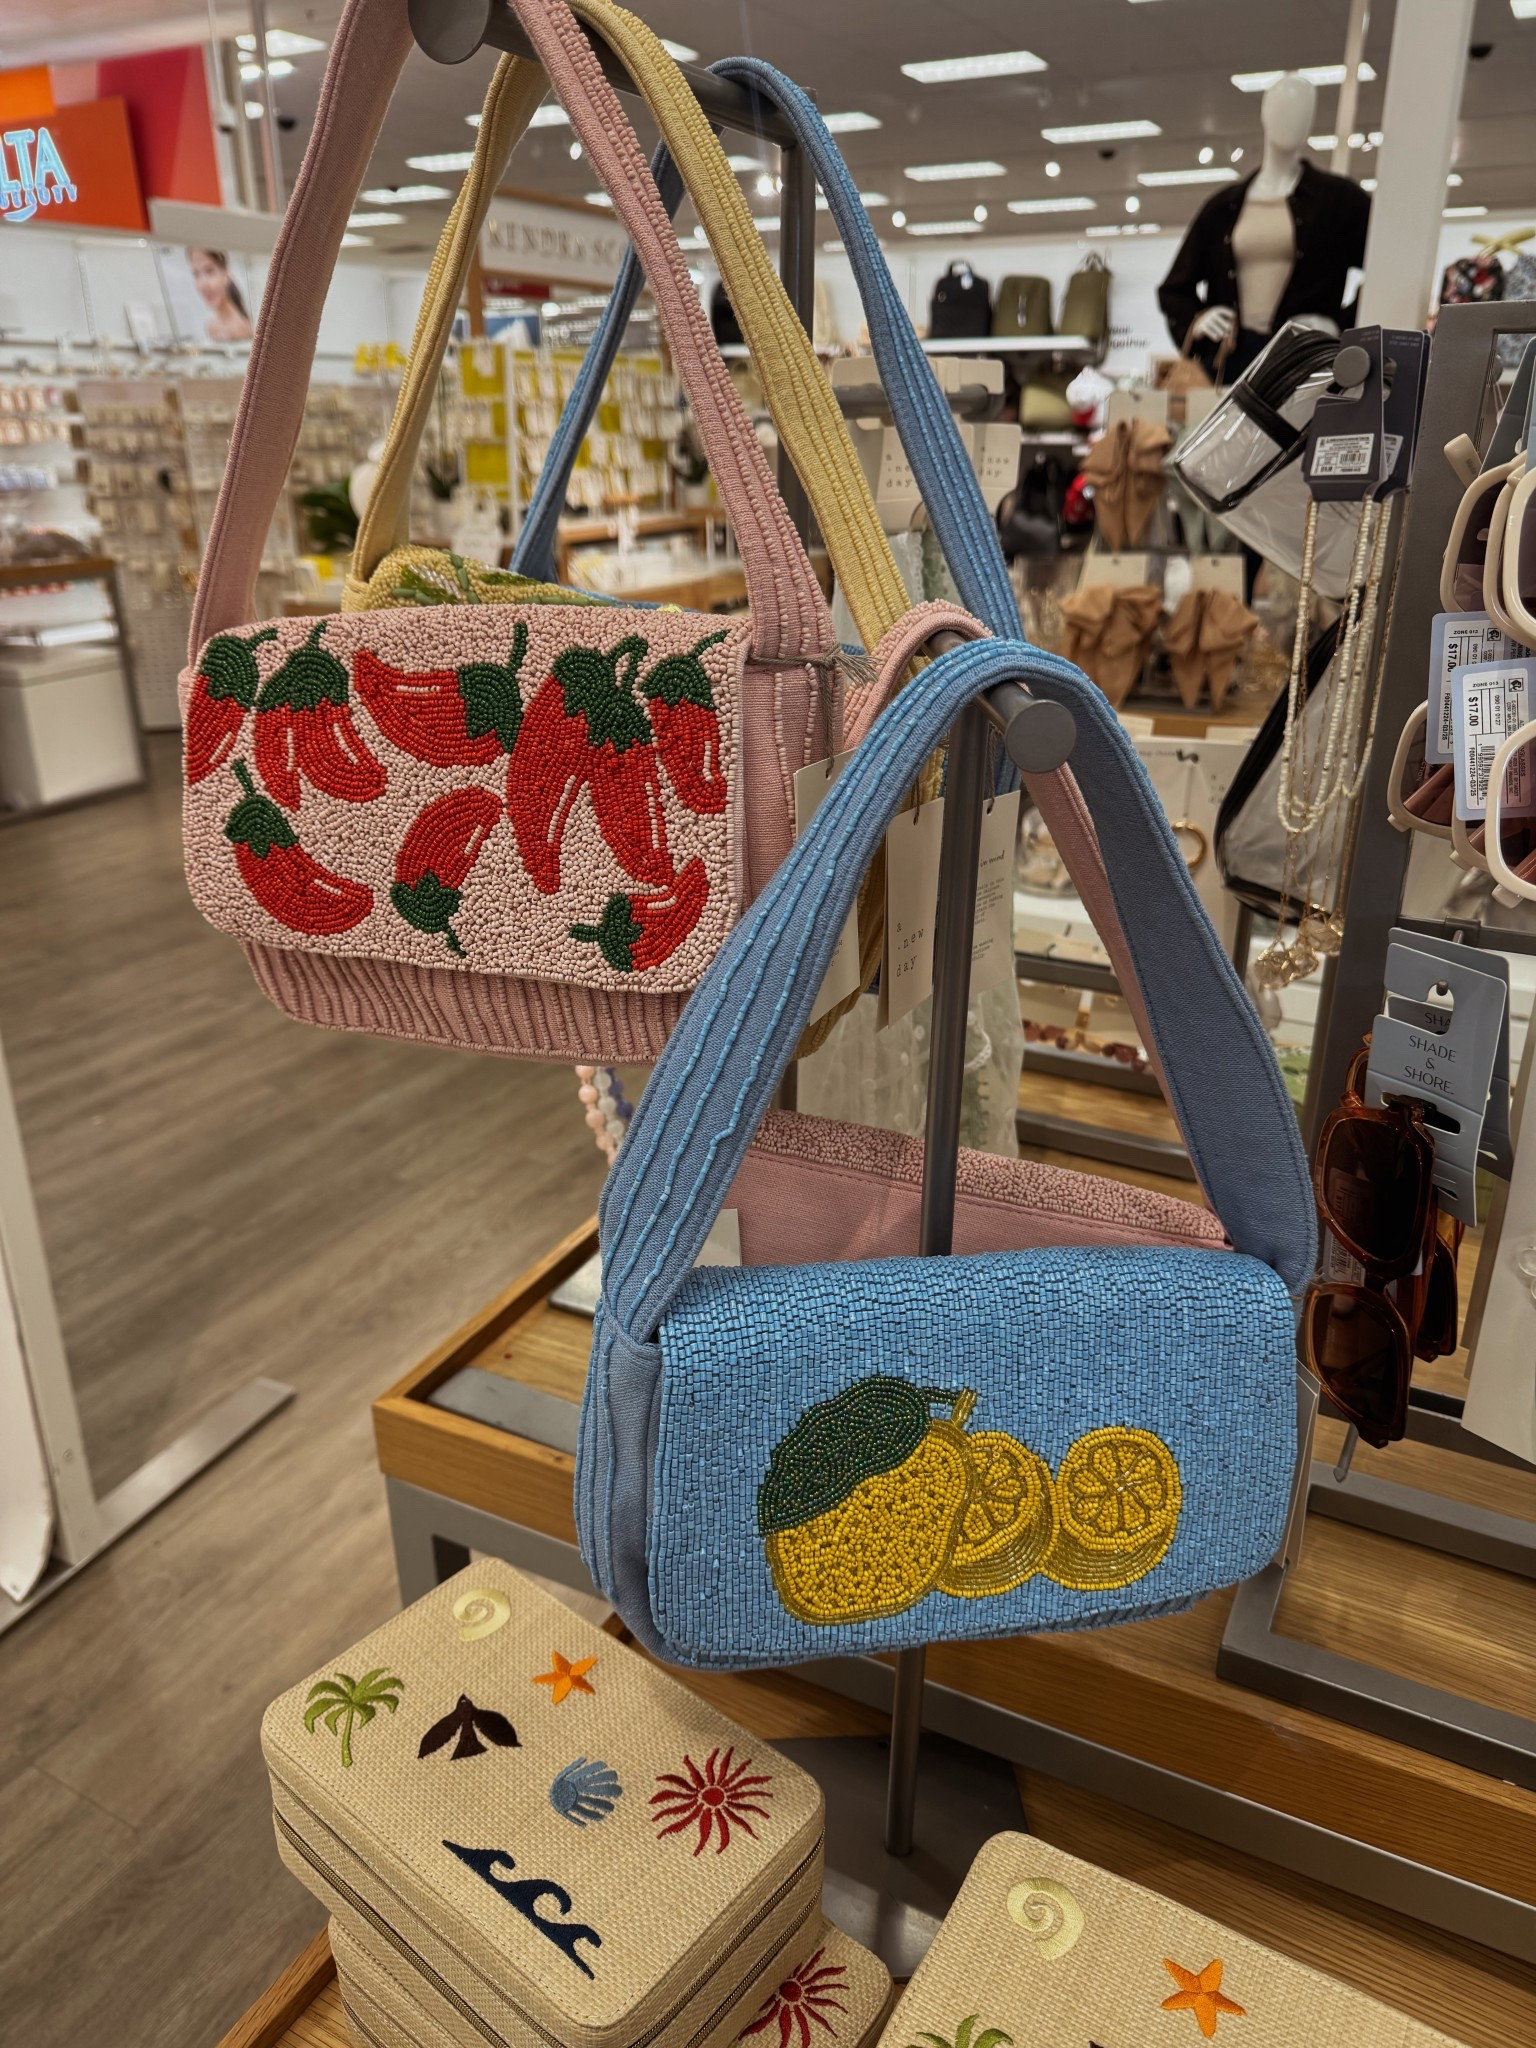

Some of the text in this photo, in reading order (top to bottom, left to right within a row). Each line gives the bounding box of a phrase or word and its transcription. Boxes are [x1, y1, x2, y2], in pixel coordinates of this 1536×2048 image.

[0, 127, 72, 196] LTA
[1468, 697, 1479, 727] $17.00
[903, 928, 924, 949] new
[896, 955, 918, 978] day
[1424, 1012, 1451, 1027] SHA
[1408, 1034, 1457, 1063] SHADE
[1425, 1057, 1435, 1070] &
